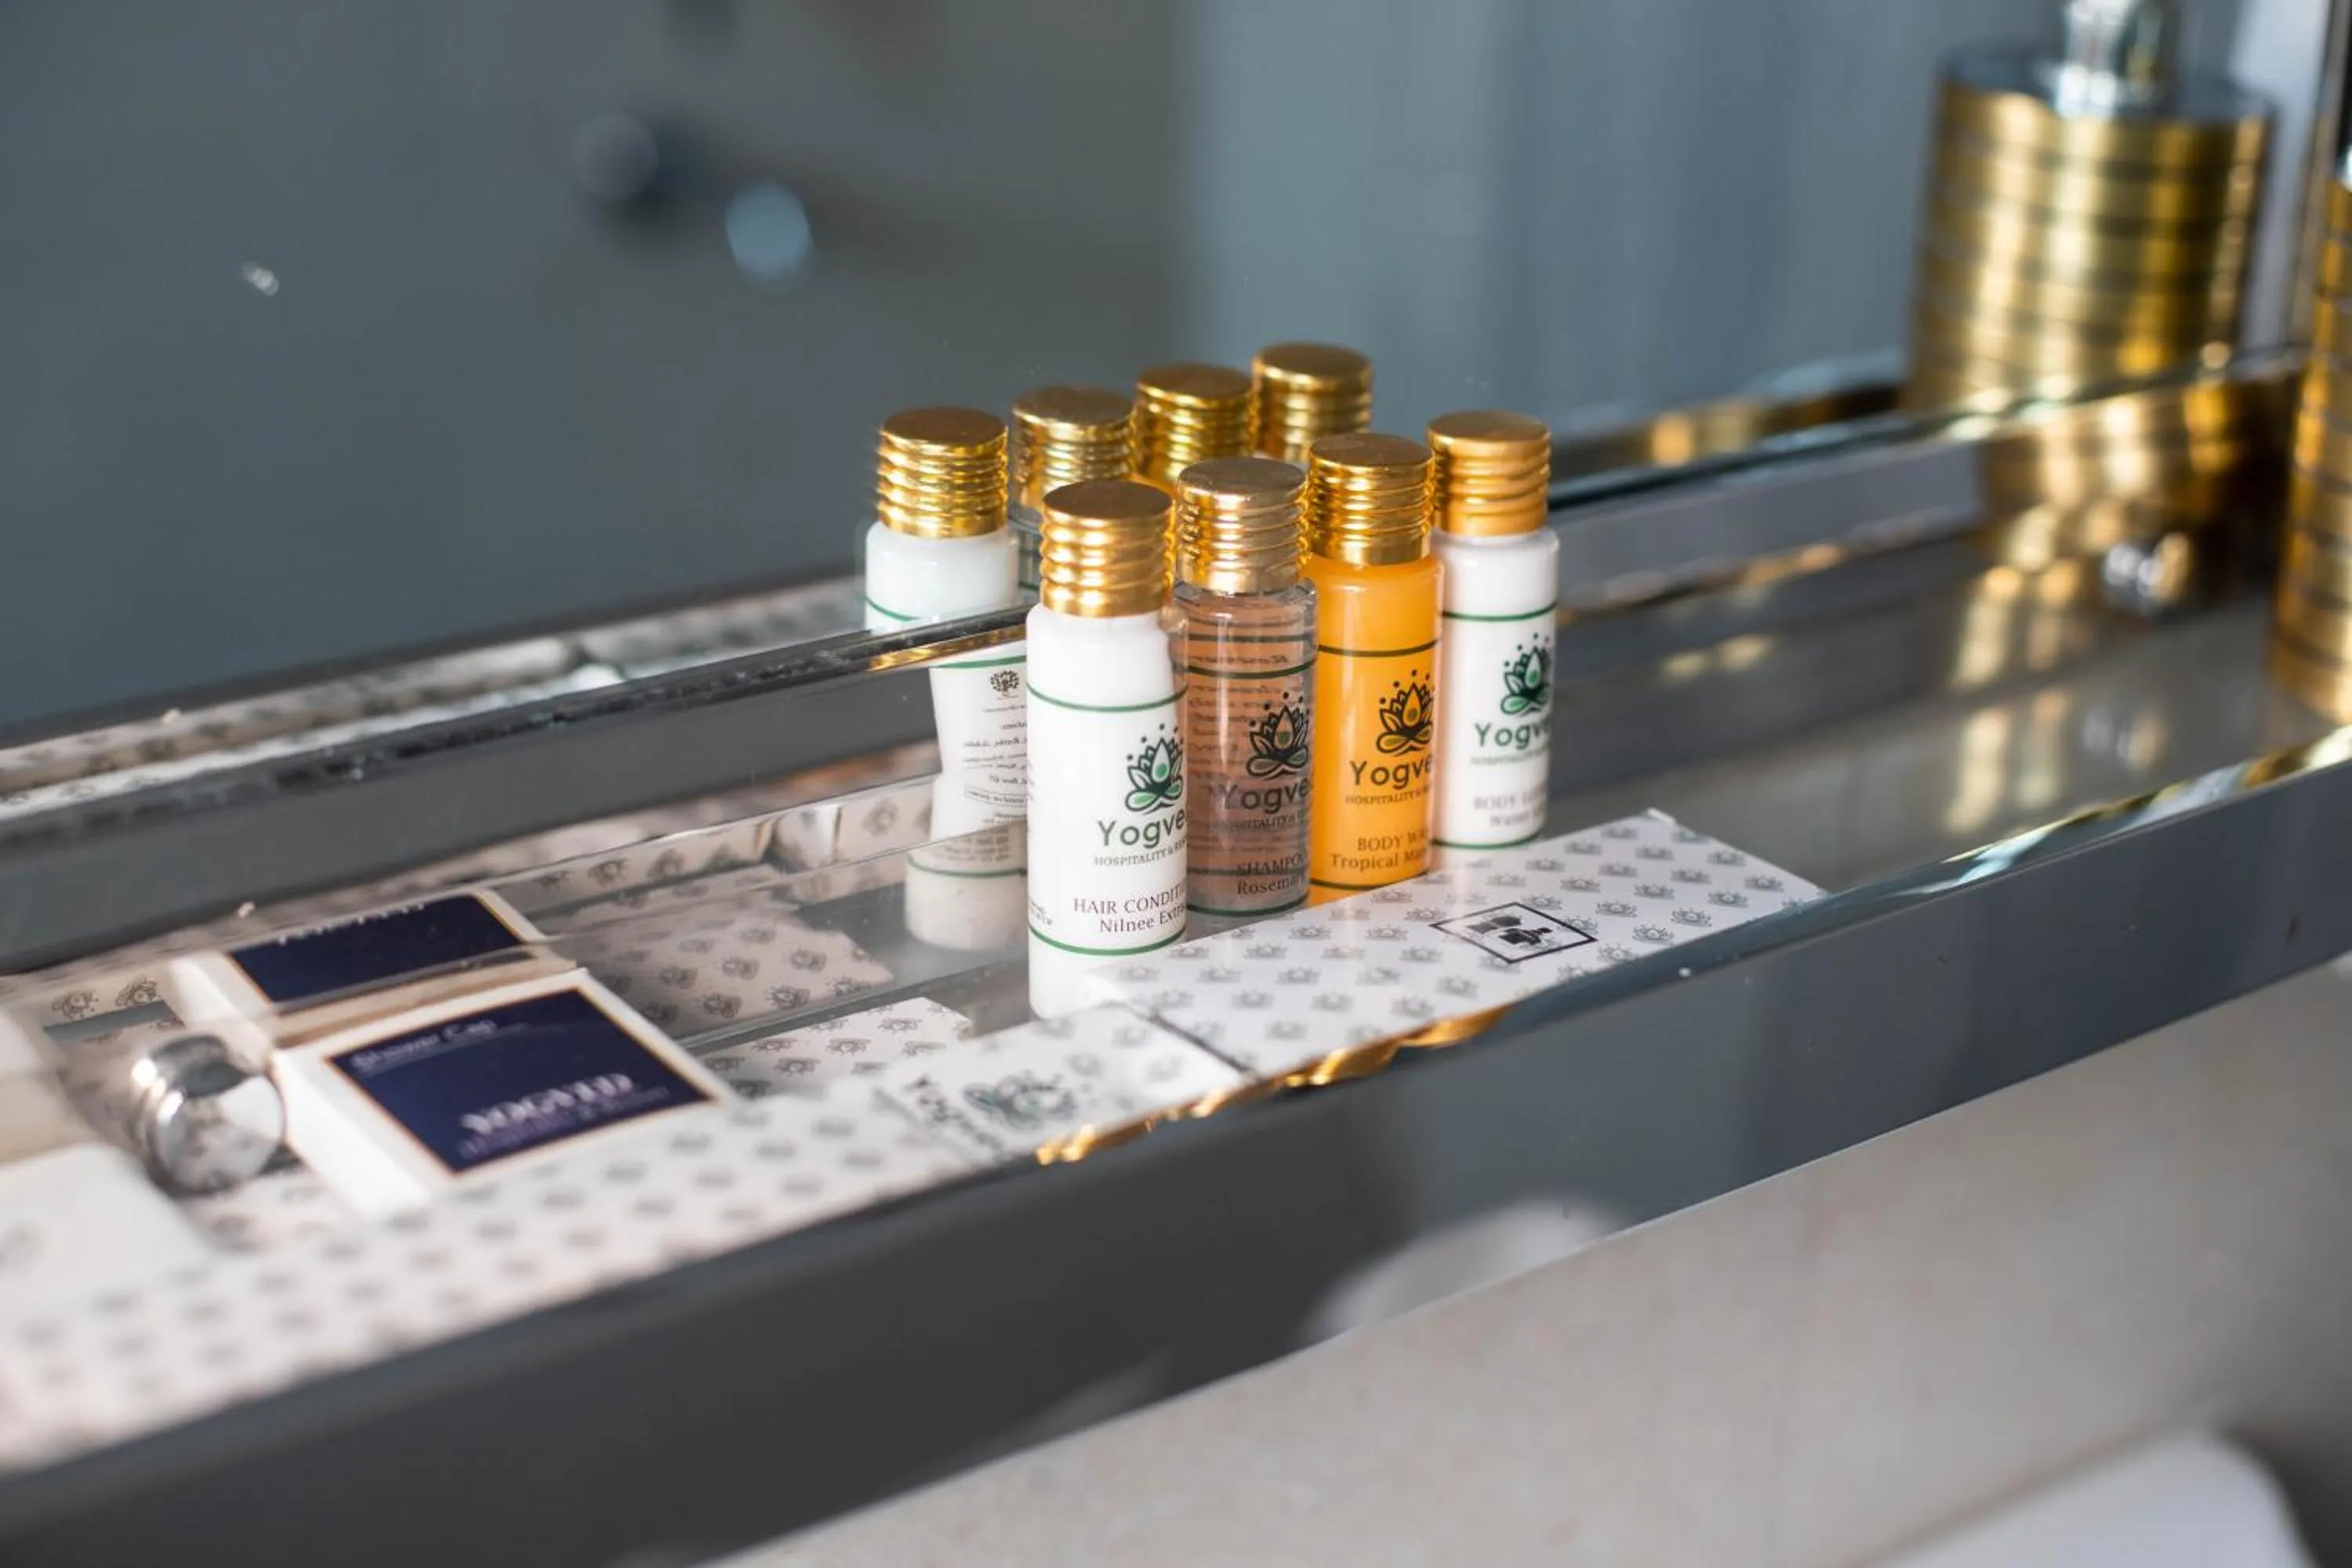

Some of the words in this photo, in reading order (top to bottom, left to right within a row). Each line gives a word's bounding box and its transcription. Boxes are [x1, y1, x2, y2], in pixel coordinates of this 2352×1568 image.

[1475, 718, 1548, 750] Yogv
[1357, 835, 1402, 851] BODY
[1094, 848, 1167, 866] HOSPITALITY
[1330, 851, 1399, 873] Tropical
[1073, 897, 1118, 915] HAIR
[1123, 884, 1183, 914] CONDIT
[1100, 916, 1155, 934] Nilnee
[443, 1018, 499, 1042] Cap
